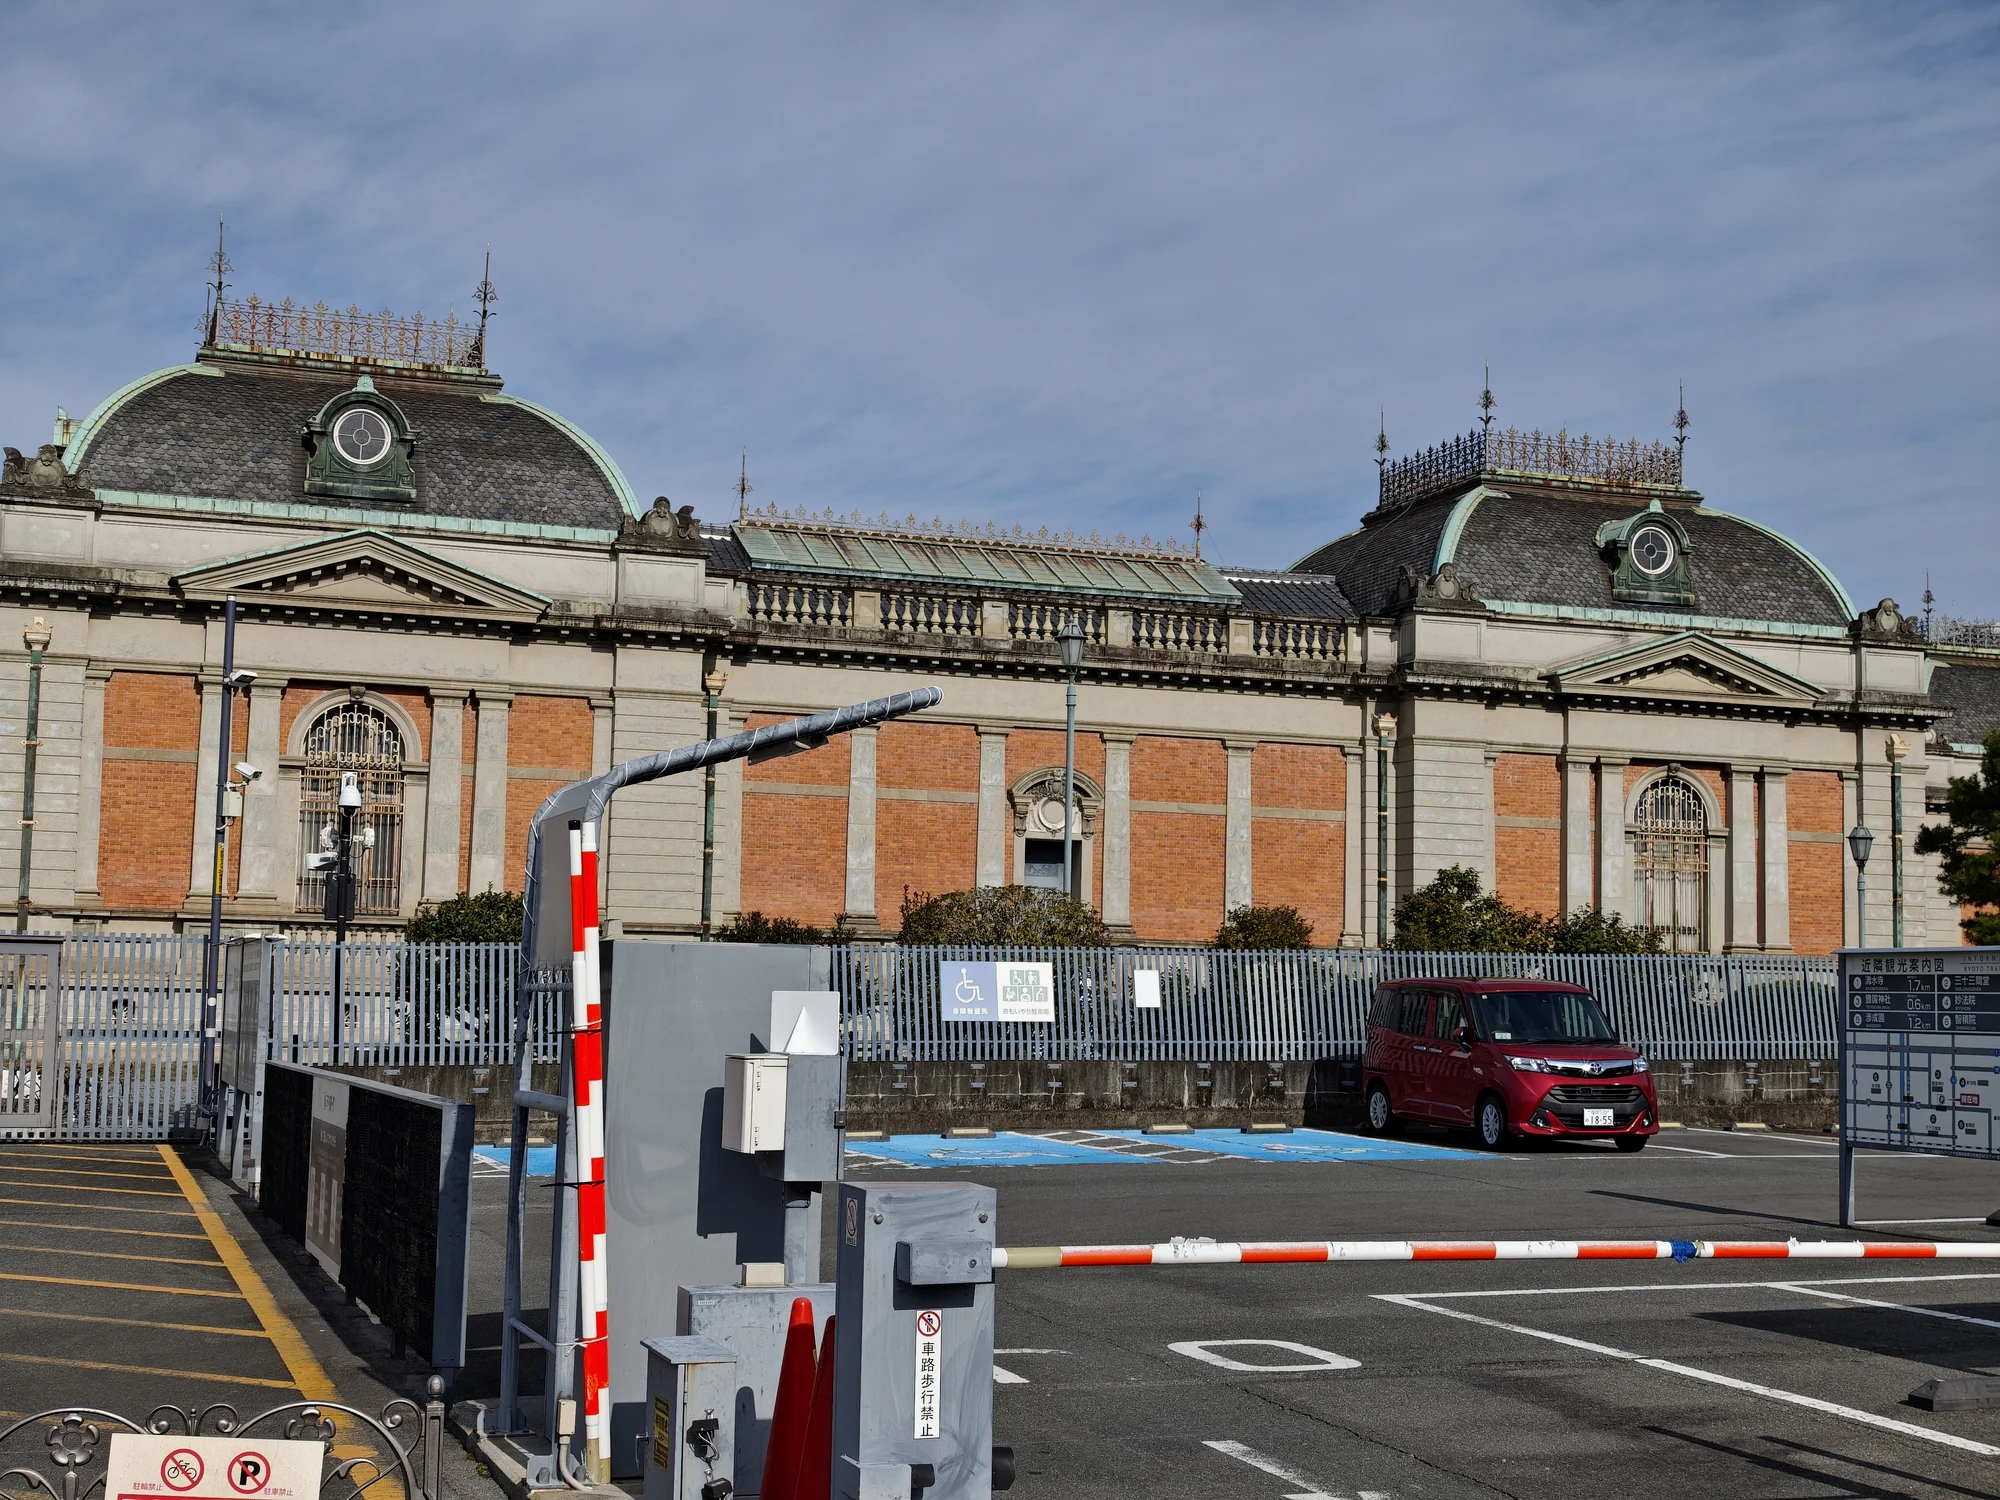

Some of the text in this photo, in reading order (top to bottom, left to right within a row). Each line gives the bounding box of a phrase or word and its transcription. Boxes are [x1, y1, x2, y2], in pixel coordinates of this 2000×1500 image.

[1861, 958, 1944, 973] 近隣観光案内図
[1865, 976, 1884, 986] 清水寺
[1954, 975, 1990, 986] 三十三間堂
[1865, 994, 1891, 1005] 豊国神社
[1955, 995, 1976, 1005] 妙法院
[1955, 1014, 1976, 1025] 智積院
[1961, 1095, 1978, 1105] 現在地
[1591, 1115, 1612, 1124] 18-55
[920, 1341, 936, 1438] 車路歩行禁止
[132, 1482, 164, 1491] 駐輪禁止
[263, 1487, 294, 1497] 駐車禁止
